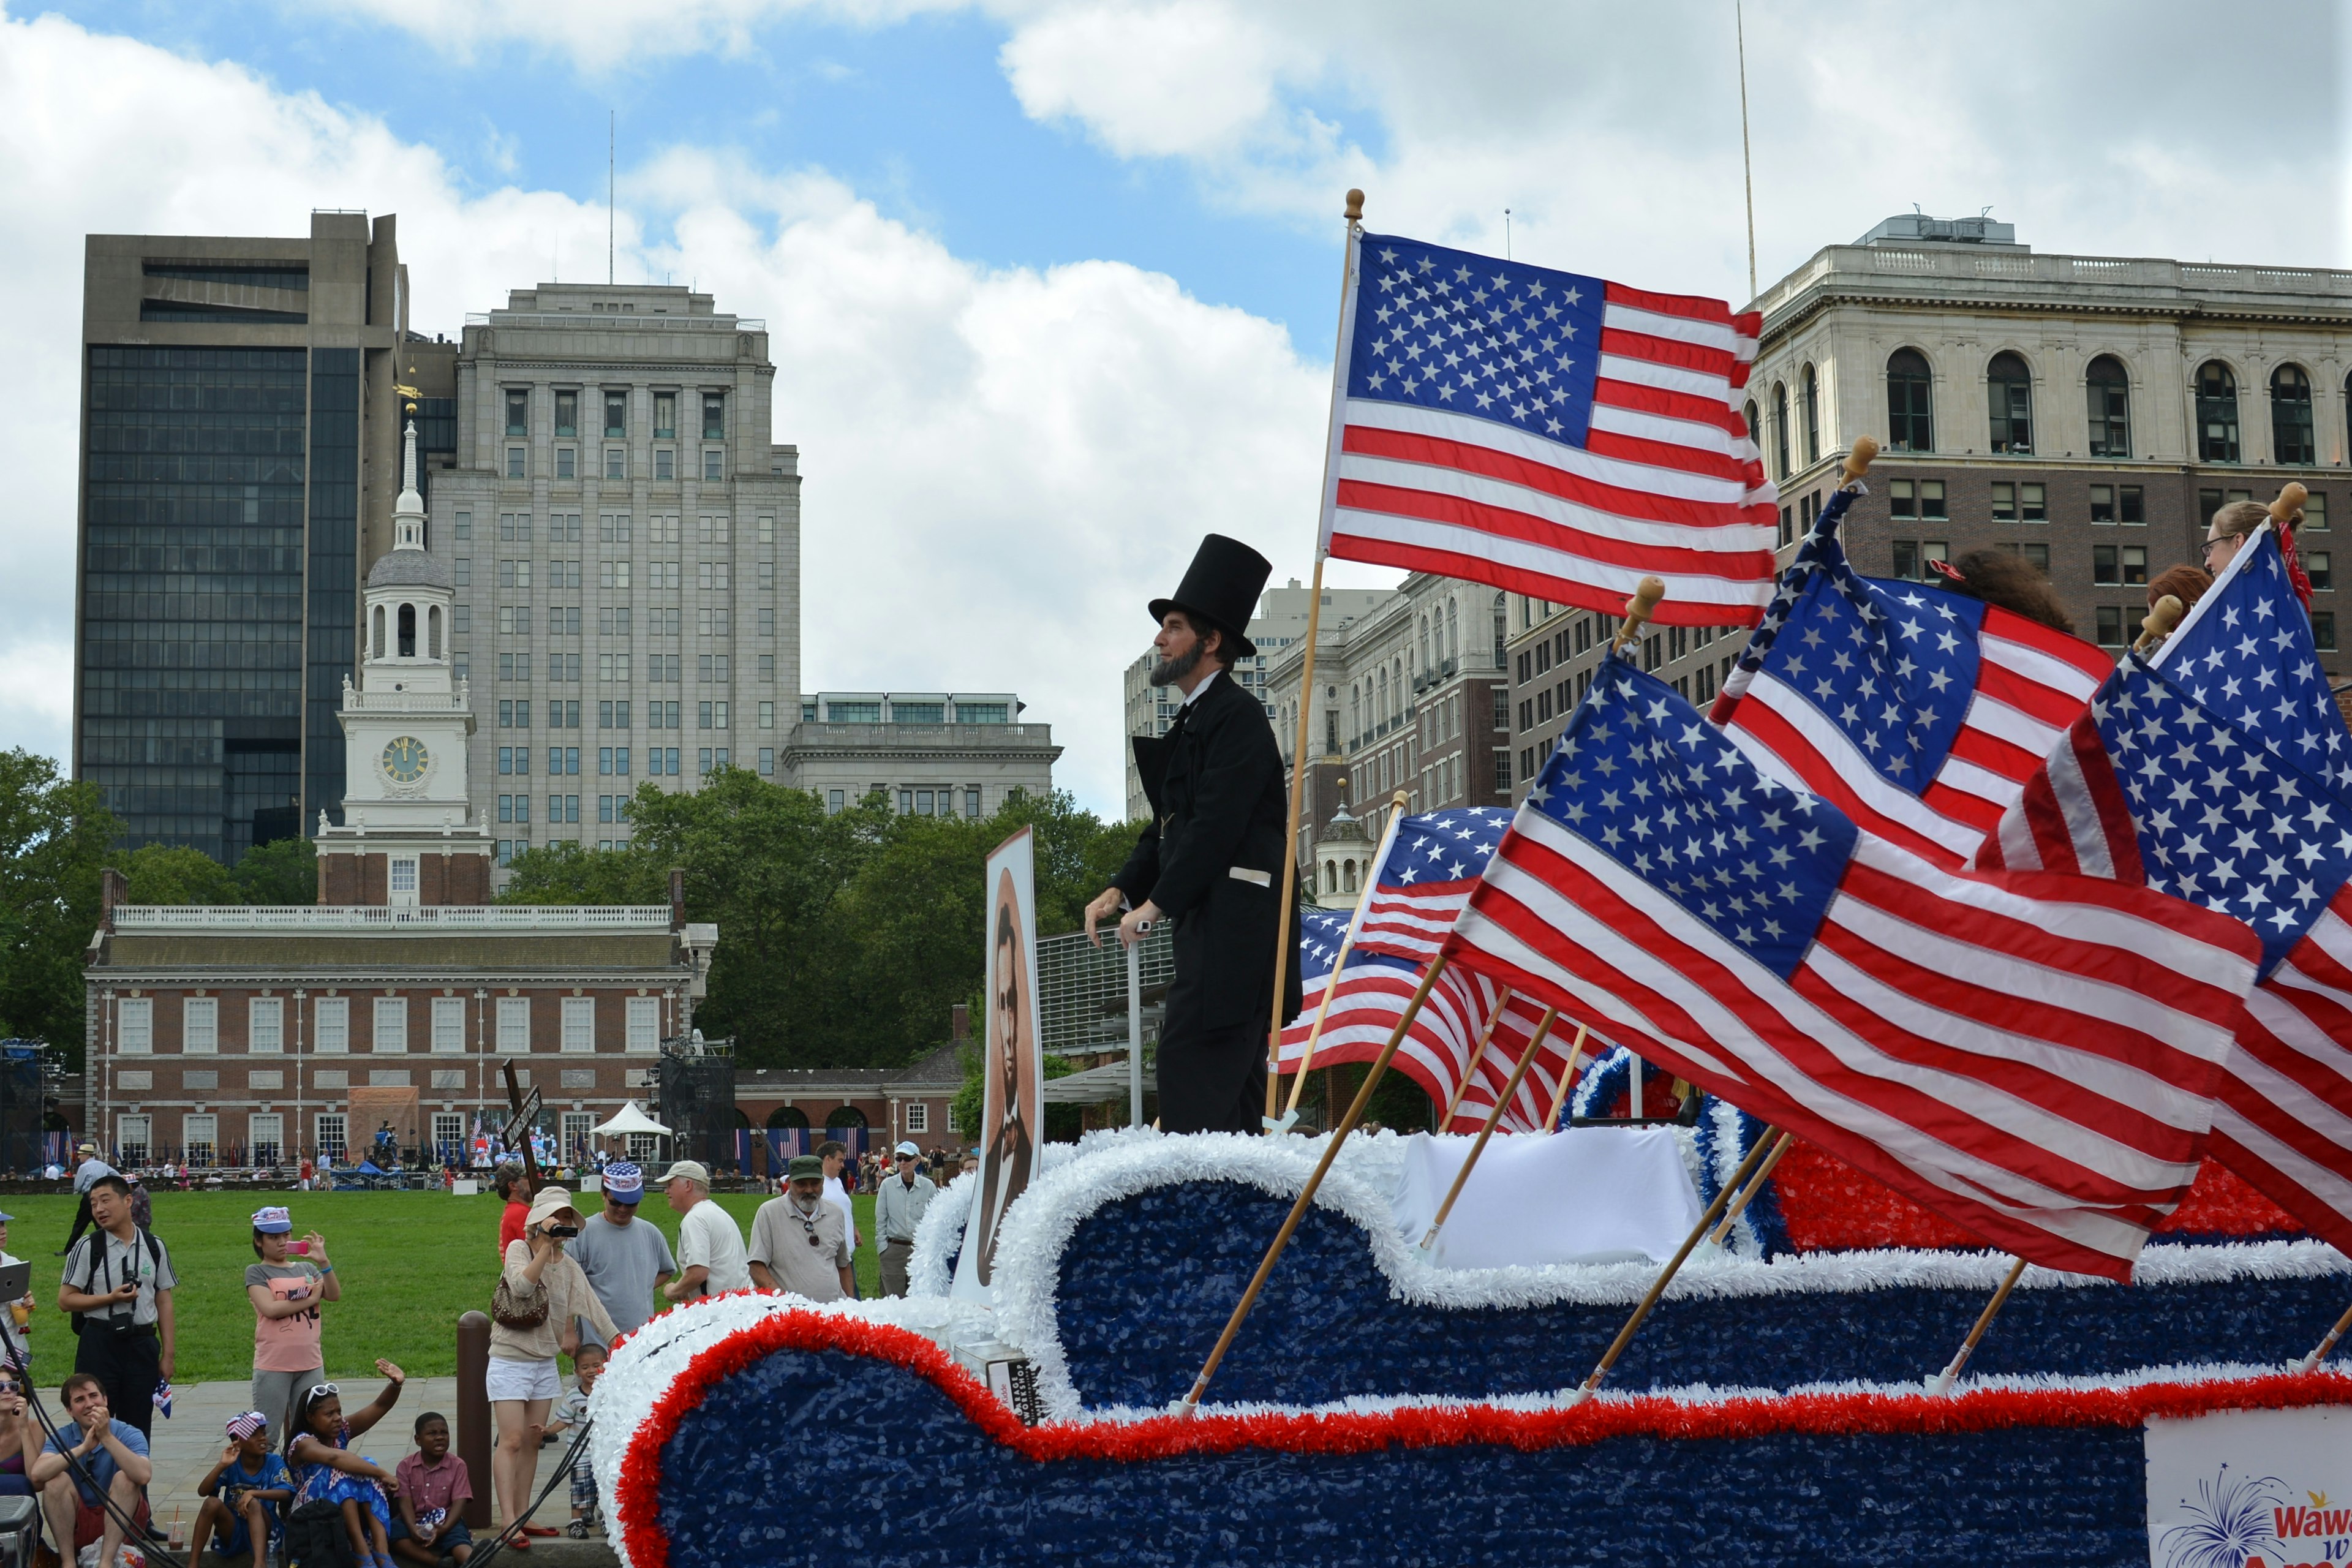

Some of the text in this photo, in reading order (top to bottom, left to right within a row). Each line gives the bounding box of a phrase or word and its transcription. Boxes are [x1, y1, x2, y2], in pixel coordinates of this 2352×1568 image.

[507, 1092, 540, 1147] NO KING BUT CHRIST
[1011, 1377, 1023, 1416] GARAGE
[1017, 1365, 1030, 1419] WORKSHOP
[2274, 1506, 2352, 1539] Waw
